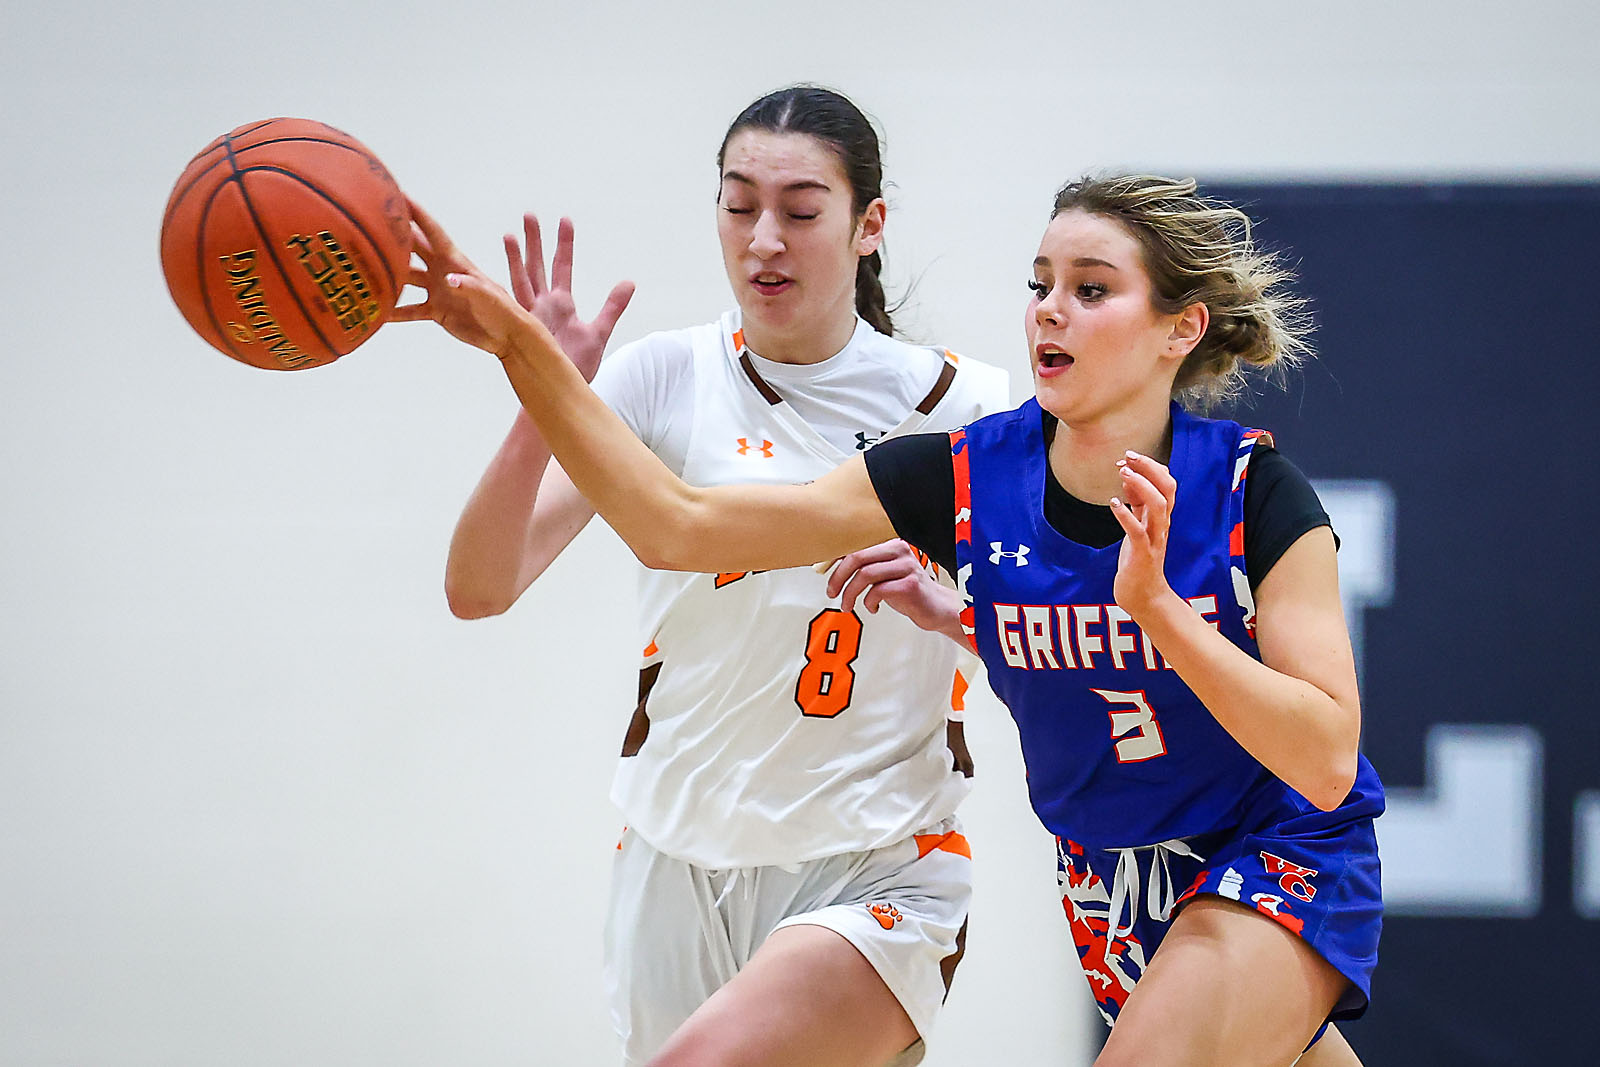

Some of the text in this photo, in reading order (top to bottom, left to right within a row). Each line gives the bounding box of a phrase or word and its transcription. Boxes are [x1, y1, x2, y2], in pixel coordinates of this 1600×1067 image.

[218, 249, 320, 368] SPALDING
[794, 607, 864, 719] 8
[1089, 687, 1168, 763] 3
